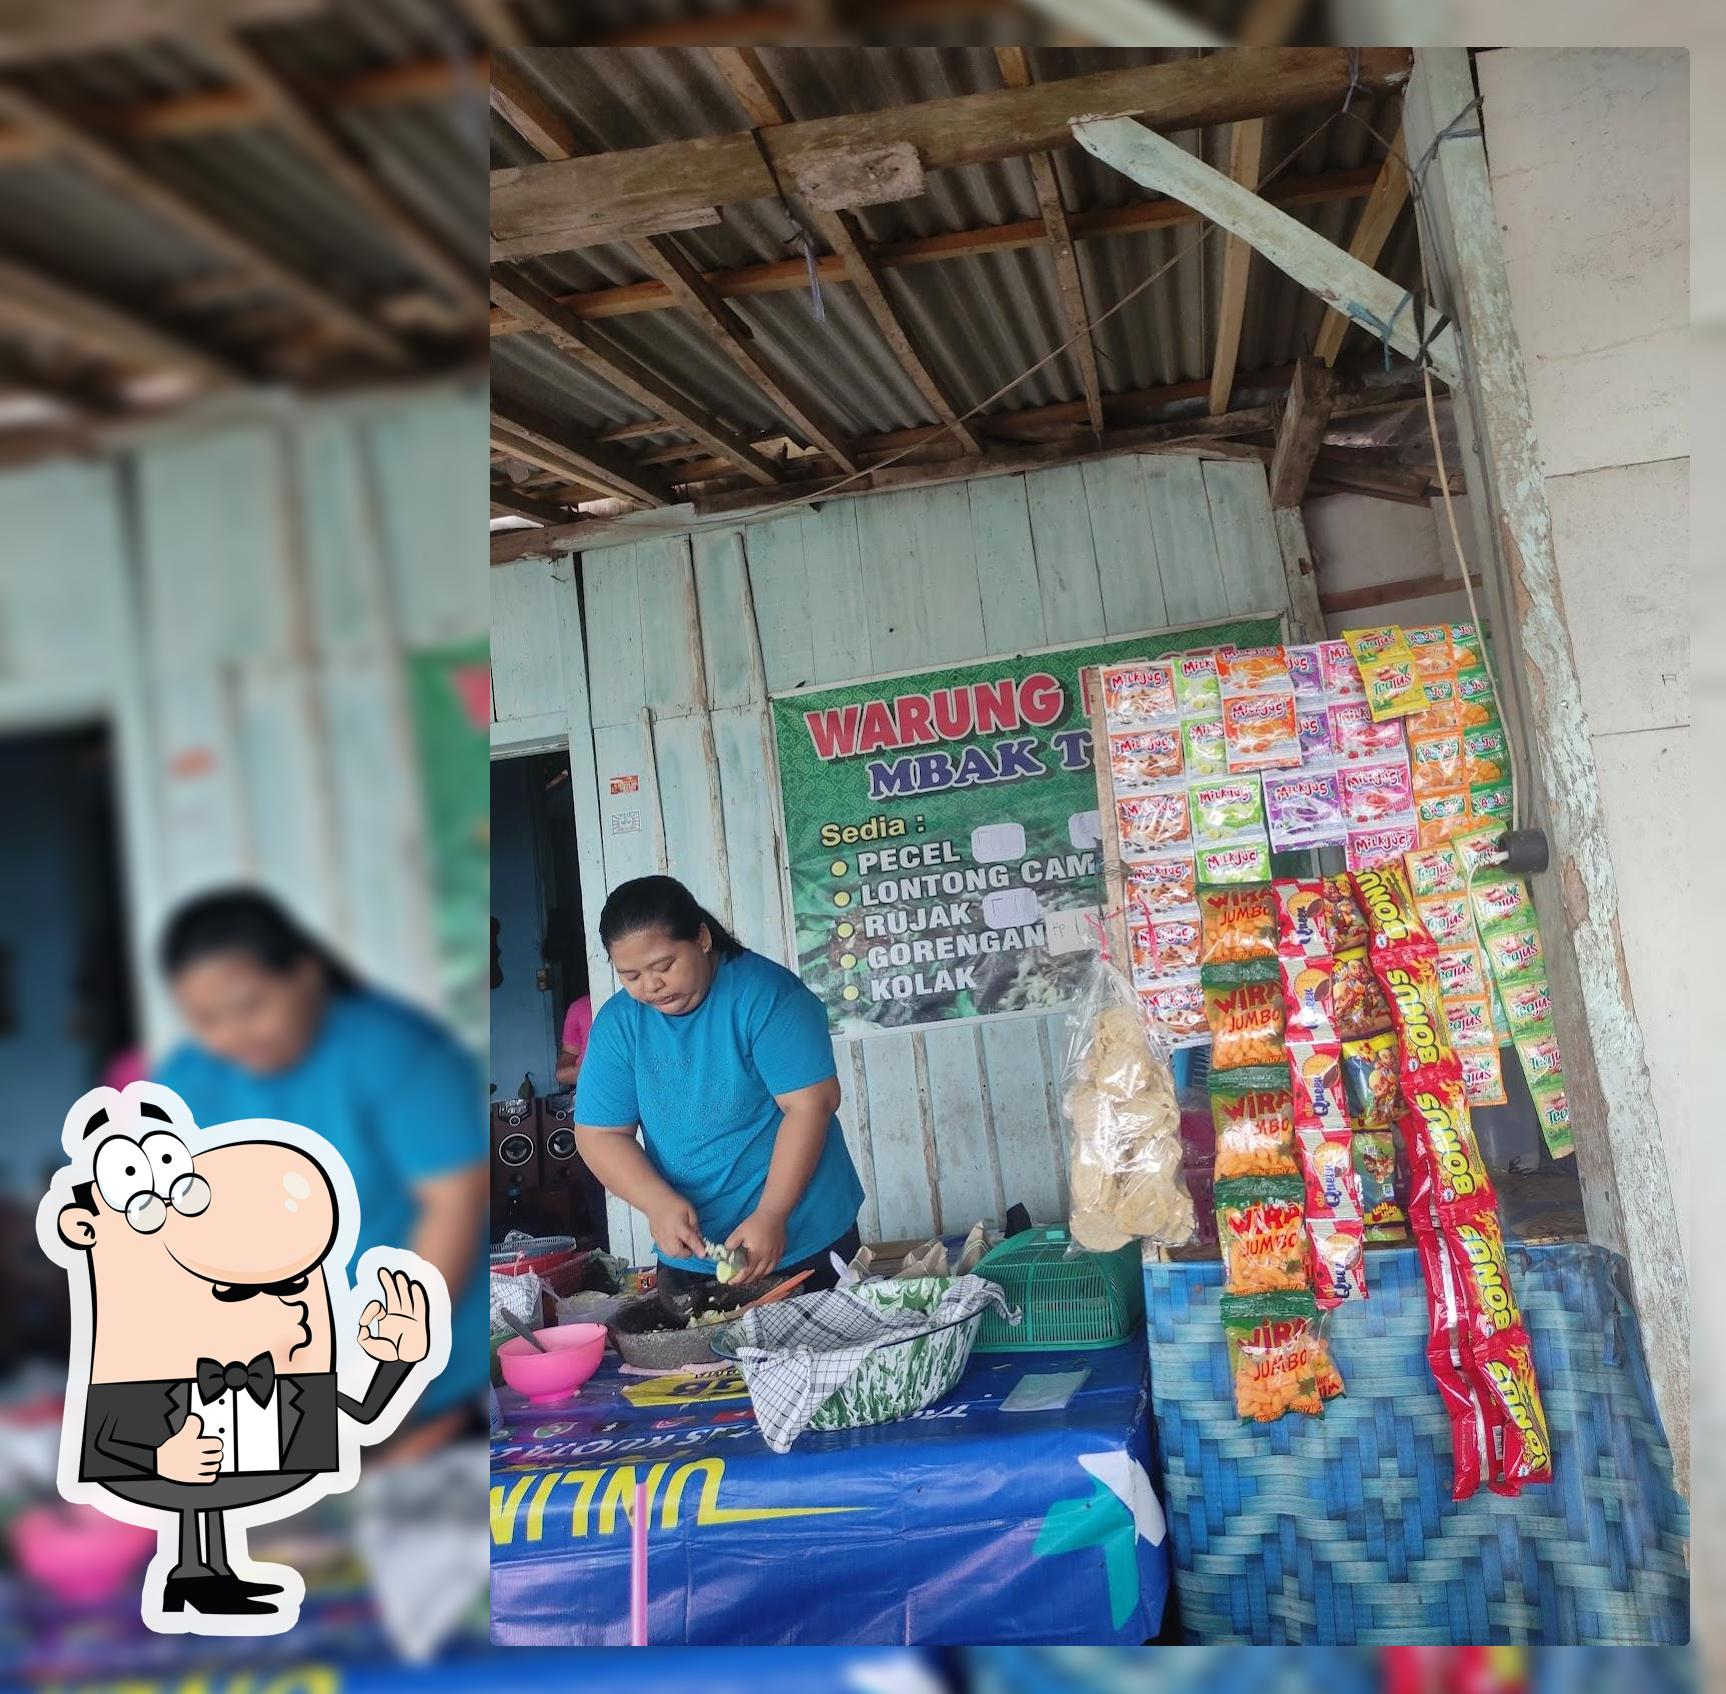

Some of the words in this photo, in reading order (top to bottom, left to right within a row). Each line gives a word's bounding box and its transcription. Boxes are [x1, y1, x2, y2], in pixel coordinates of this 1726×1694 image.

[804, 671, 1065, 762] WARUNG
[867, 736, 1047, 802] MBAK
[819, 816, 906, 848] Sedia
[856, 841, 961, 876] PECEL
[859, 865, 1010, 907] LONTONG
[864, 902, 973, 938] RUJAK
[1220, 906, 1271, 926] JUMBO
[866, 925, 1047, 970] GORENGAN
[870, 966, 978, 1002] KOLAK
[1228, 1009, 1281, 1033] JUMBO
[1386, 967, 1440, 1064] BONUS
[1312, 1076, 1331, 1117] Queen
[1415, 1093, 1475, 1196] BONUS
[1323, 1163, 1343, 1208] Queen
[1334, 1262, 1352, 1299] Que
[1456, 1224, 1512, 1331] BONUS
[1253, 1349, 1308, 1382] JUMBO
